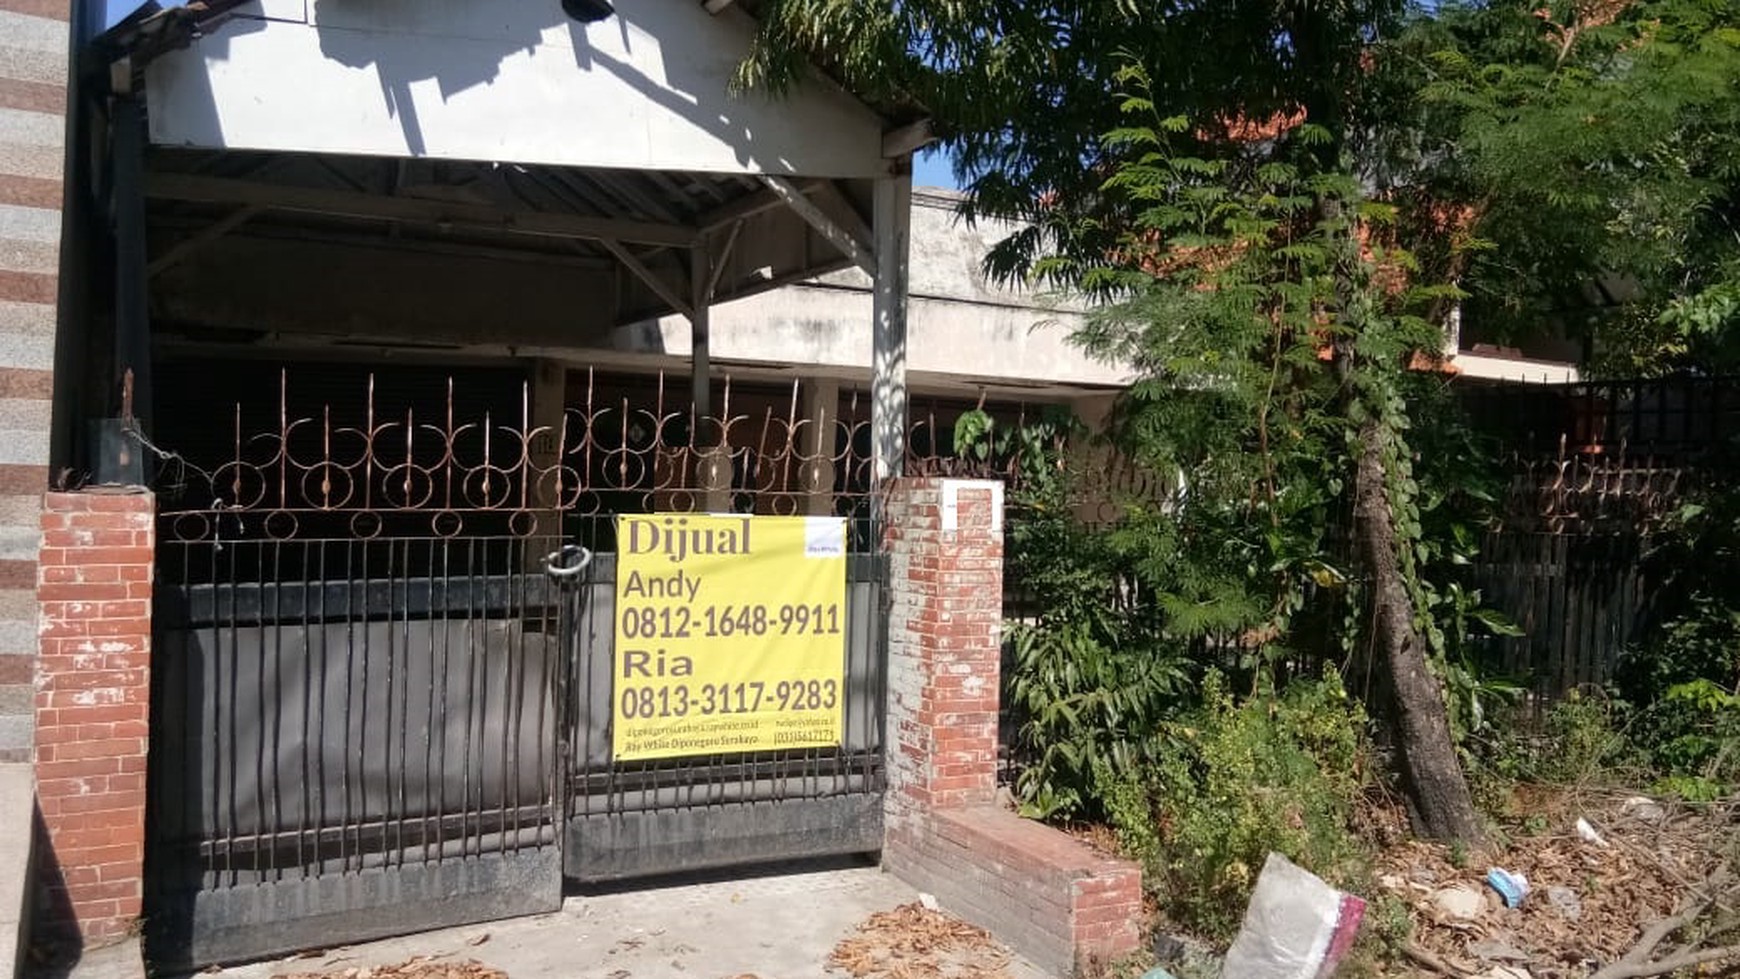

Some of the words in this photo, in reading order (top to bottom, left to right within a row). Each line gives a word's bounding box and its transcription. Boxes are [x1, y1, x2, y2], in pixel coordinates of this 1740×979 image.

[628, 518, 752, 562] Dijual
[623, 569, 701, 603] Andy
[622, 604, 840, 639] 0812-1648-9911
[623, 649, 693, 679] Ria
[621, 679, 837, 719] 0813-3117-9283
